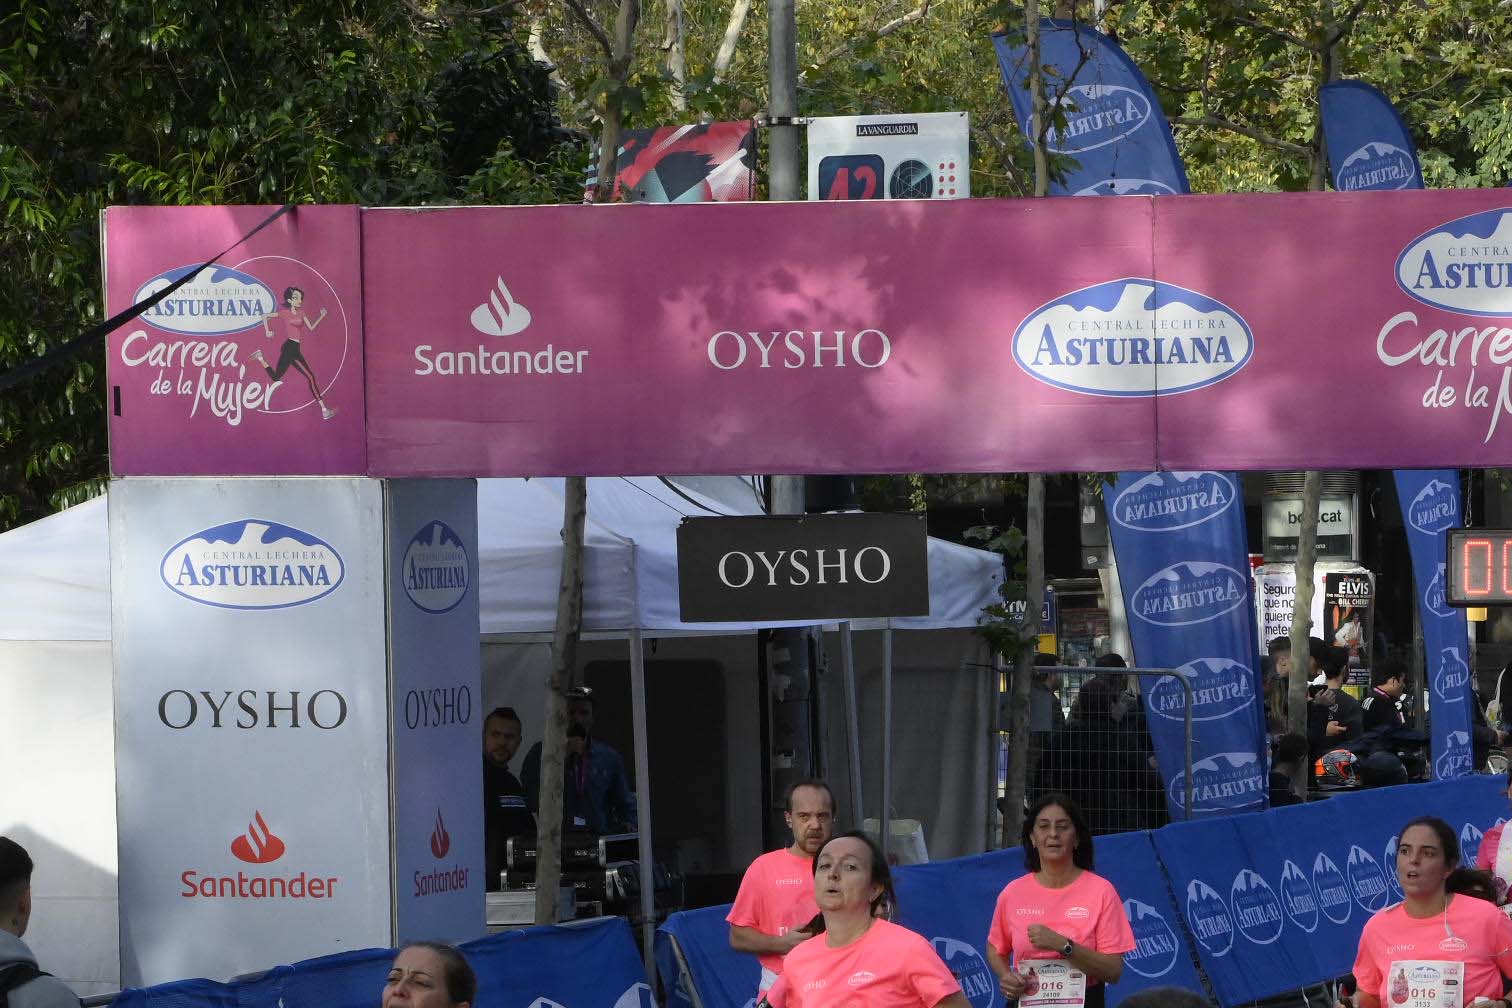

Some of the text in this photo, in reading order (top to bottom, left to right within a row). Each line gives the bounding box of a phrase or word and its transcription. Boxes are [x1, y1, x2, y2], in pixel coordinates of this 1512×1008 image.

[145, 289, 264, 317] ASTURIANA
[1068, 318, 1227, 332] CENTRAL LECHERA
[121, 330, 237, 368] Carrera
[415, 344, 589, 375] Santander
[708, 329, 891, 369] OYSHO
[1031, 323, 1234, 366] ASTURIANA
[150, 371, 193, 396] de la
[191, 365, 286, 426] Mujer
[1423, 370, 1488, 408] de la
[176, 553, 331, 586] ASTURIANA
[204, 551, 324, 559] CENTRAL LECHERA
[718, 546, 890, 588] OYSHO
[408, 558, 465, 591] ASTURIANA
[1339, 582, 1369, 594] ELVIS
[1264, 599, 1280, 609] que
[158, 689, 347, 730] OYSHO
[405, 685, 472, 730] OYSHO
[181, 870, 338, 899] Santander
[414, 865, 469, 897] Santander
[1041, 982, 1063, 990] 016
[1411, 988, 1435, 999] 016
